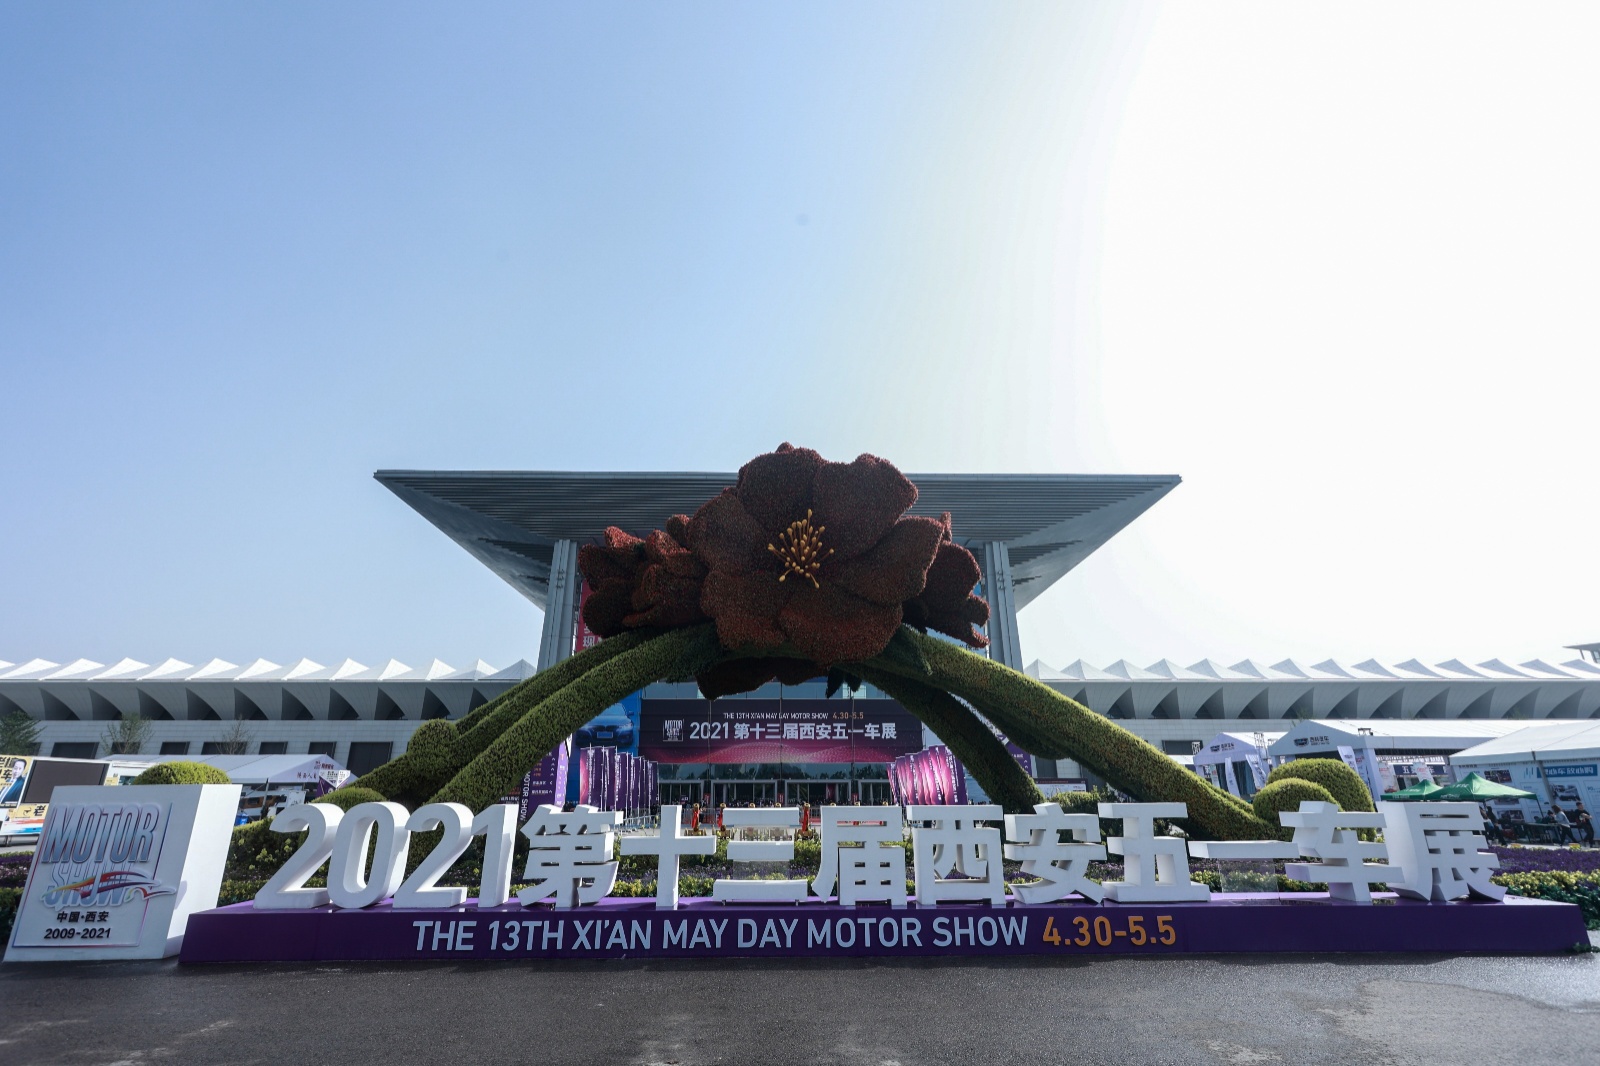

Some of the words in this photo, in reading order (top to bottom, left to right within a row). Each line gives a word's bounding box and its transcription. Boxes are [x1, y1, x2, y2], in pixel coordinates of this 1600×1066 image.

[766, 712, 778, 720] MAY
[790, 712, 811, 720] MOTOR
[811, 712, 829, 720] SHOW
[689, 721, 729, 740] 2021
[734, 722, 897, 740] 第十三届西安五一车展
[42, 803, 160, 864] MOTOR
[45, 861, 131, 907] SHOW
[56, 911, 109, 923] 中国·西安
[44, 927, 111, 940] 2009-2021
[412, 920, 477, 951] THE
[488, 920, 565, 951] 13TH
[571, 919, 652, 950] XI'AN
[662, 919, 728, 949] MAY
[737, 918, 798, 948] DAY
[807, 917, 923, 948] MOTOR
[932, 916, 1028, 947] SHOW
[1042, 915, 1177, 947] 4.30-5.5
